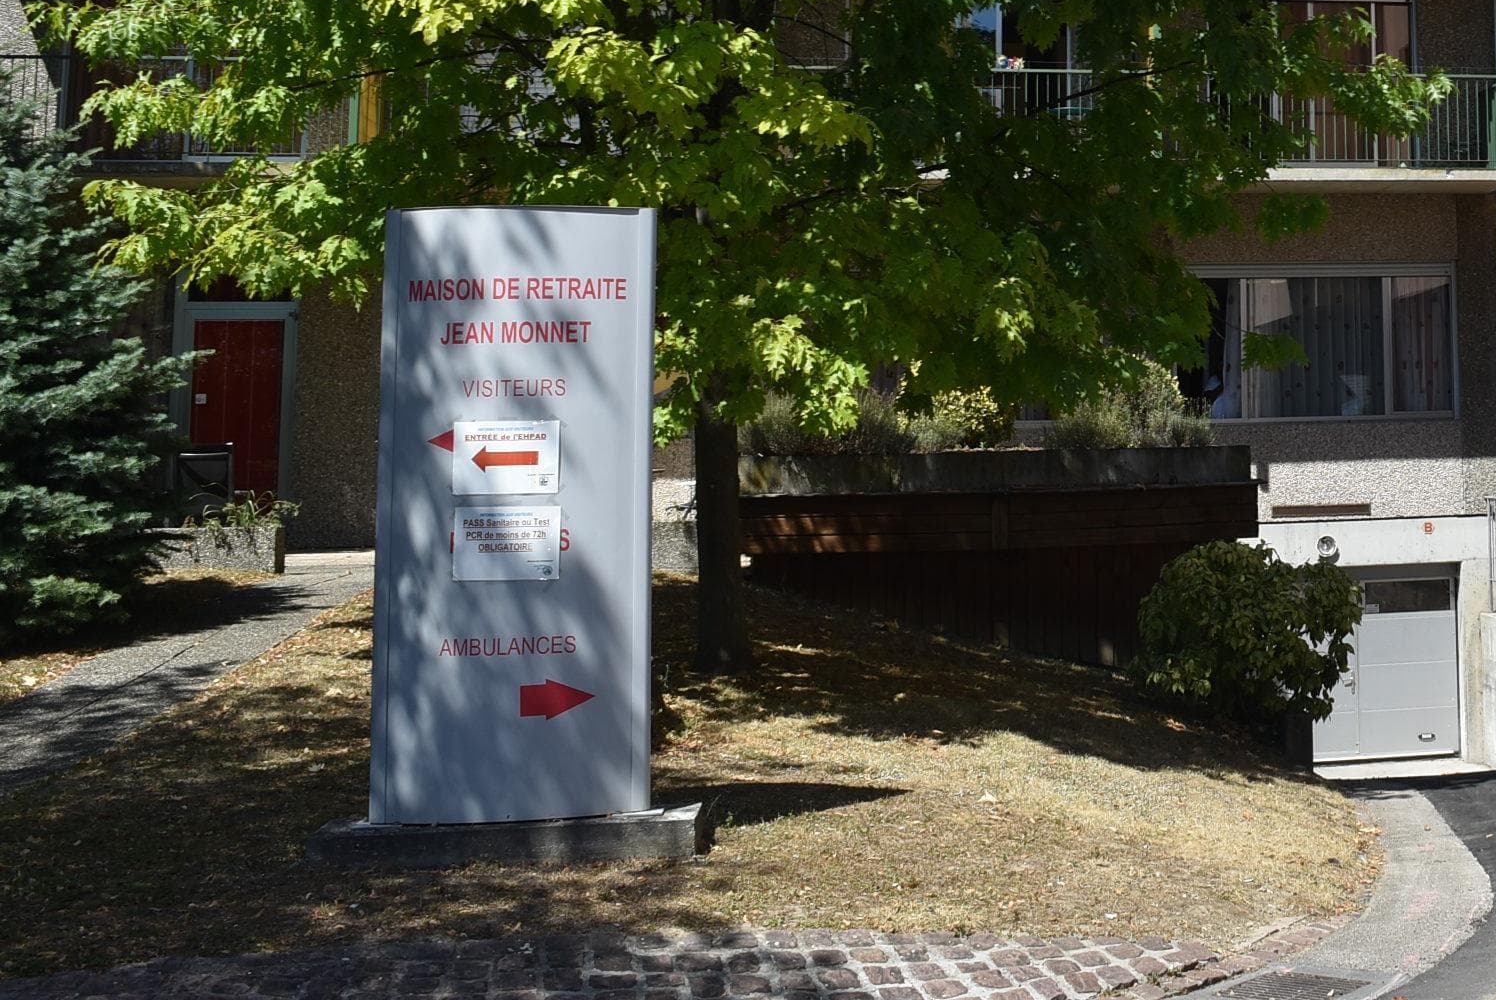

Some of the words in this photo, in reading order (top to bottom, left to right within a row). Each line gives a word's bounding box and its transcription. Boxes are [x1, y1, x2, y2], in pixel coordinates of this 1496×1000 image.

[408, 278, 484, 302] MAISON
[493, 278, 520, 300] DE
[527, 278, 627, 300] RETRAITE
[440, 322, 494, 345] JEAN
[501, 321, 591, 343] MONNET
[462, 378, 567, 398] VISITEURS
[463, 518, 485, 527] PASS
[486, 518, 520, 526] Sanitaire
[533, 518, 550, 526] Test
[465, 531, 483, 539] PCR
[484, 531, 494, 539] de
[496, 531, 519, 539] moins
[521, 530, 531, 538] de
[532, 530, 547, 538] 72h
[478, 543, 533, 552] OBLIGATOIRE
[439, 635, 577, 657] AMBULANCES
